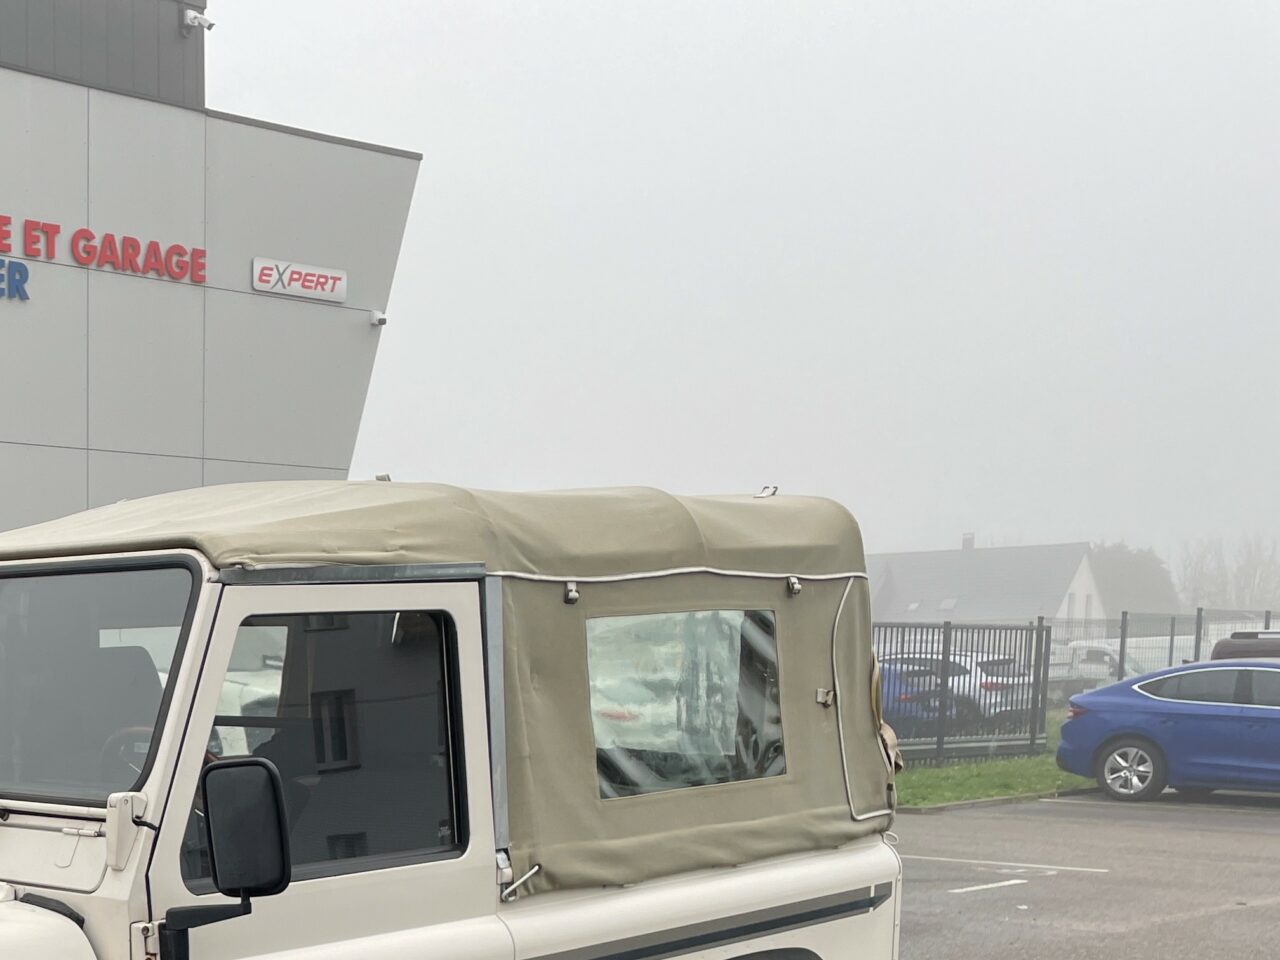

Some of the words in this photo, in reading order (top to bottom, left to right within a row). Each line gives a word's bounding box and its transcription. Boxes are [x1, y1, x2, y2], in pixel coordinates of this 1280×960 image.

[23, 218, 61, 261] ET
[70, 227, 208, 285] GARAGE
[257, 263, 343, 293] EXPERT
